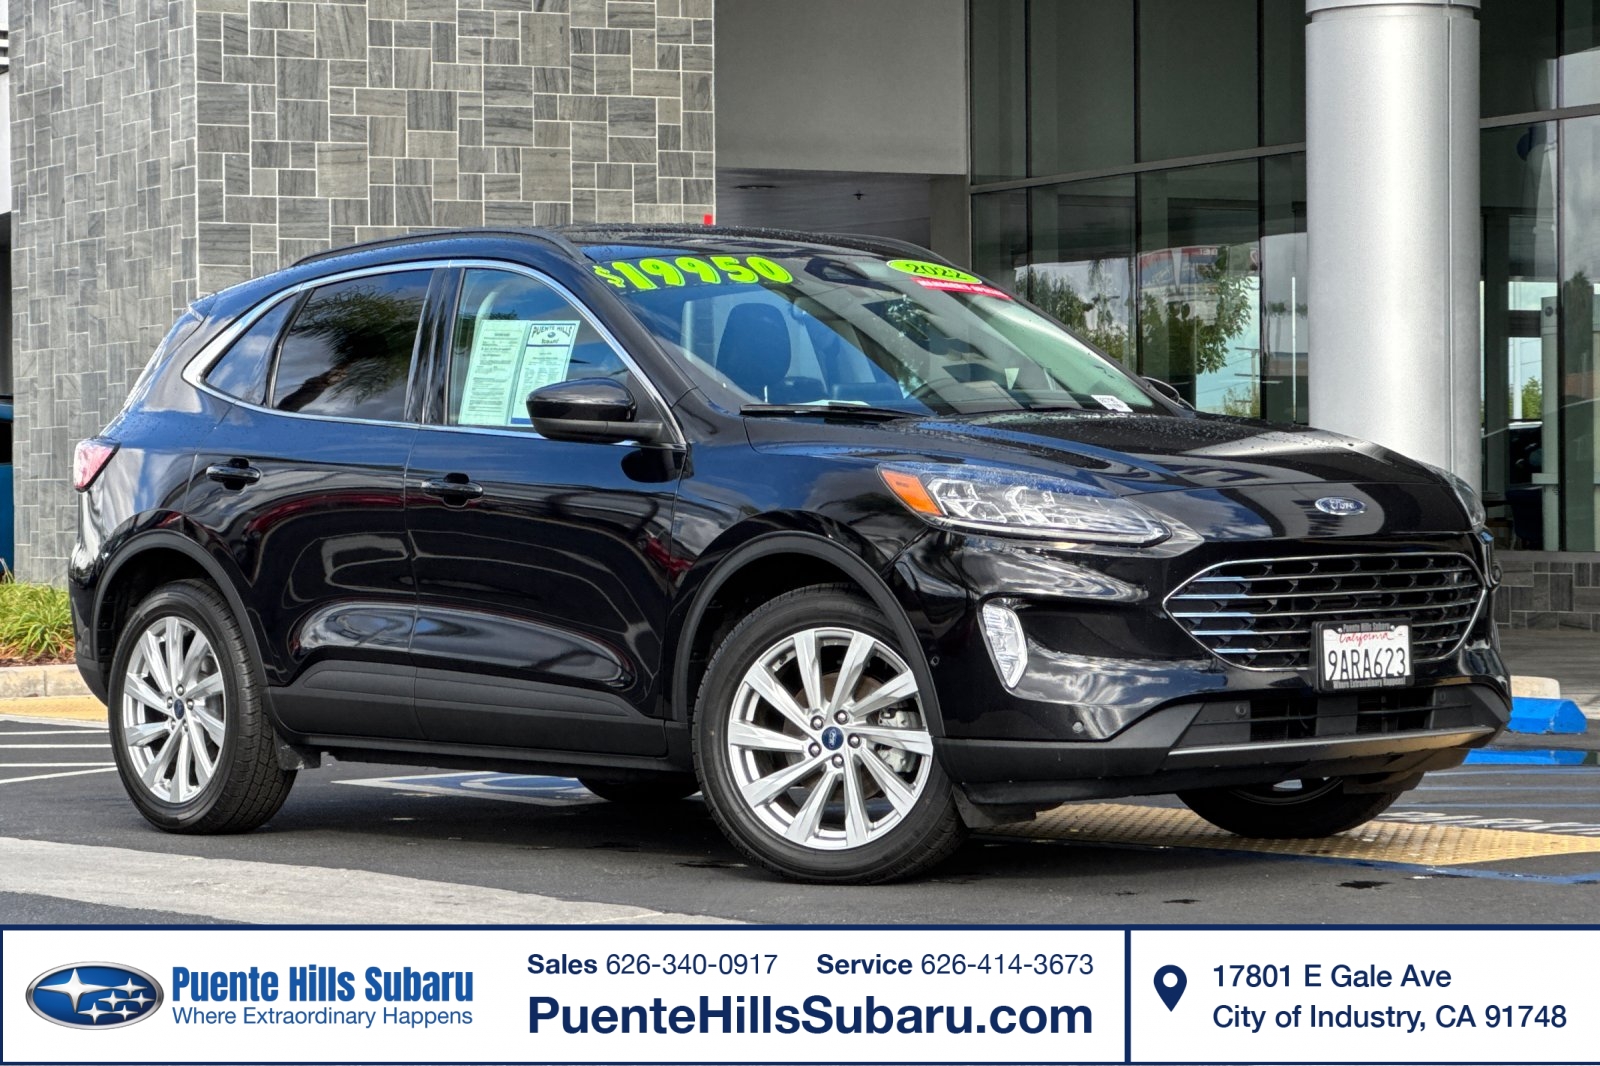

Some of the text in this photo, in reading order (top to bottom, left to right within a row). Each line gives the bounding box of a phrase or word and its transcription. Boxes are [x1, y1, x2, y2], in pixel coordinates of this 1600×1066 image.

[593, 256, 793, 290] $19950
[905, 263, 968, 280] 2022
[1340, 631, 1395, 647] California
[1328, 647, 1406, 681] 9ARA623
